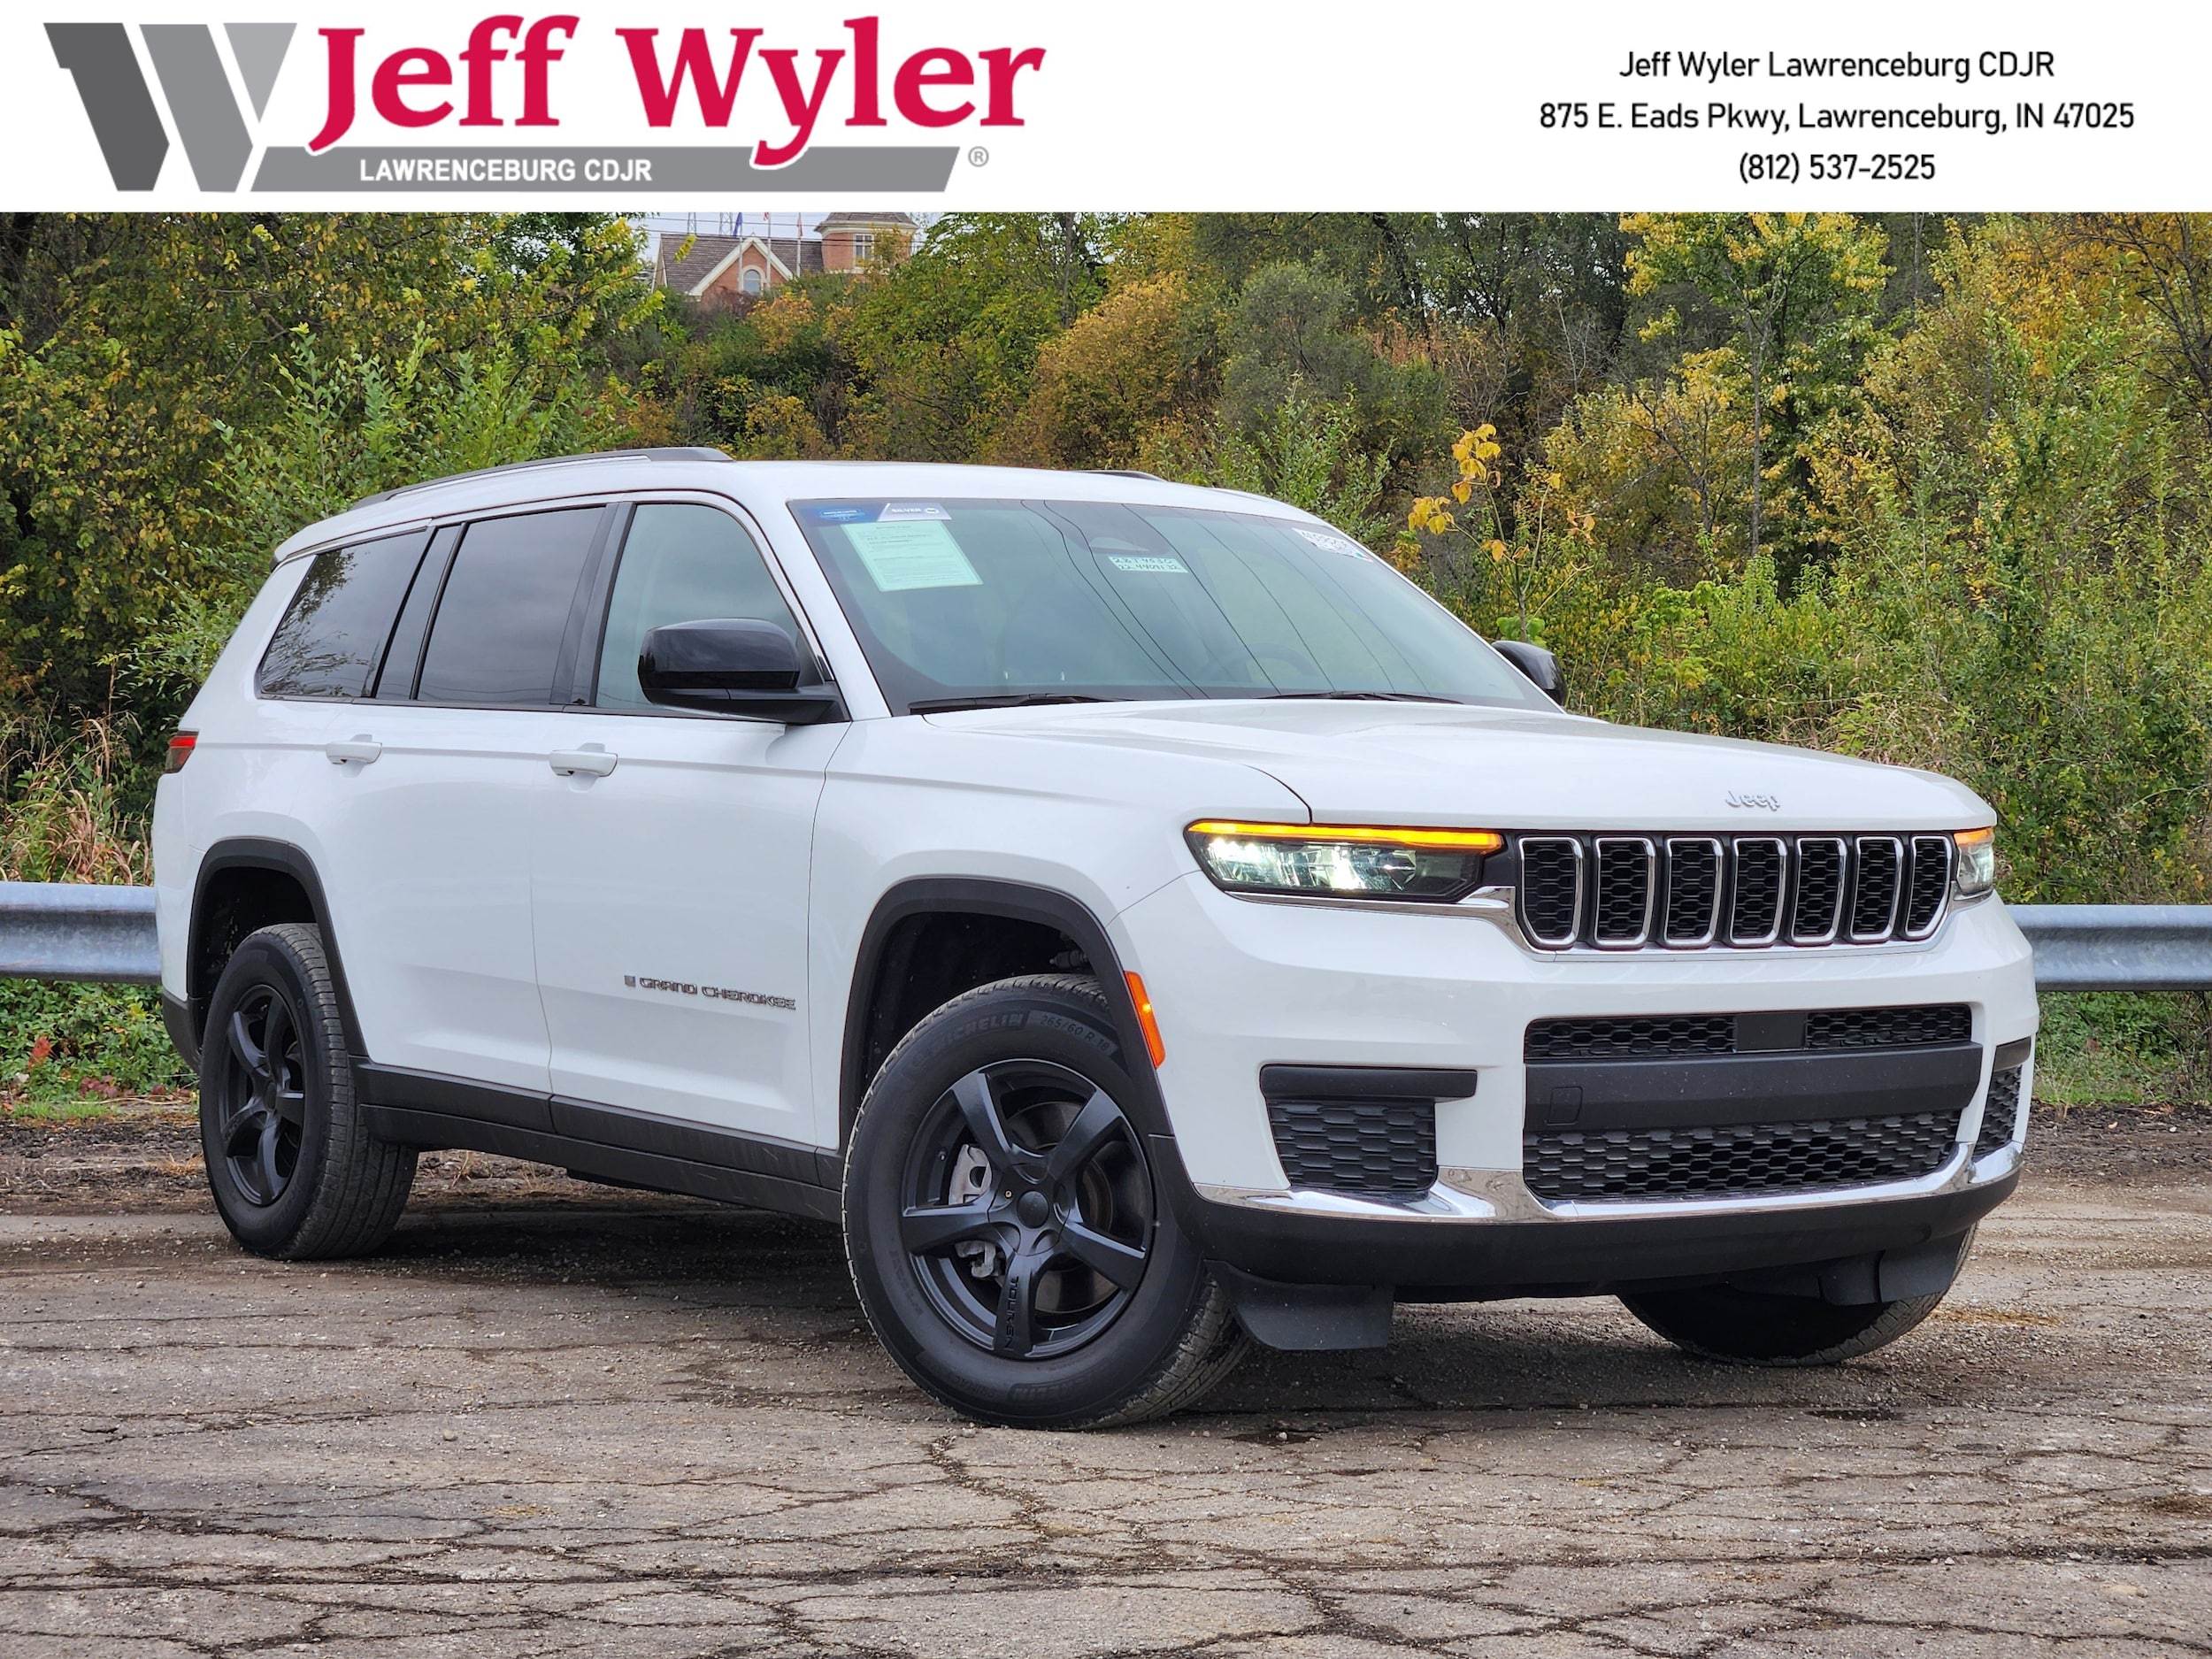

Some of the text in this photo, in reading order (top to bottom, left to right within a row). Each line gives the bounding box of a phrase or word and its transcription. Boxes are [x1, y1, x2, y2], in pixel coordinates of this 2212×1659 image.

[1724, 789, 1781, 812] Jeep
[639, 977, 796, 1010] GRAND CHEROKEE
[1041, 1015, 1084, 1035] 265/60
[1085, 1031, 1095, 1042] R
[1097, 1038, 1111, 1052] 18
